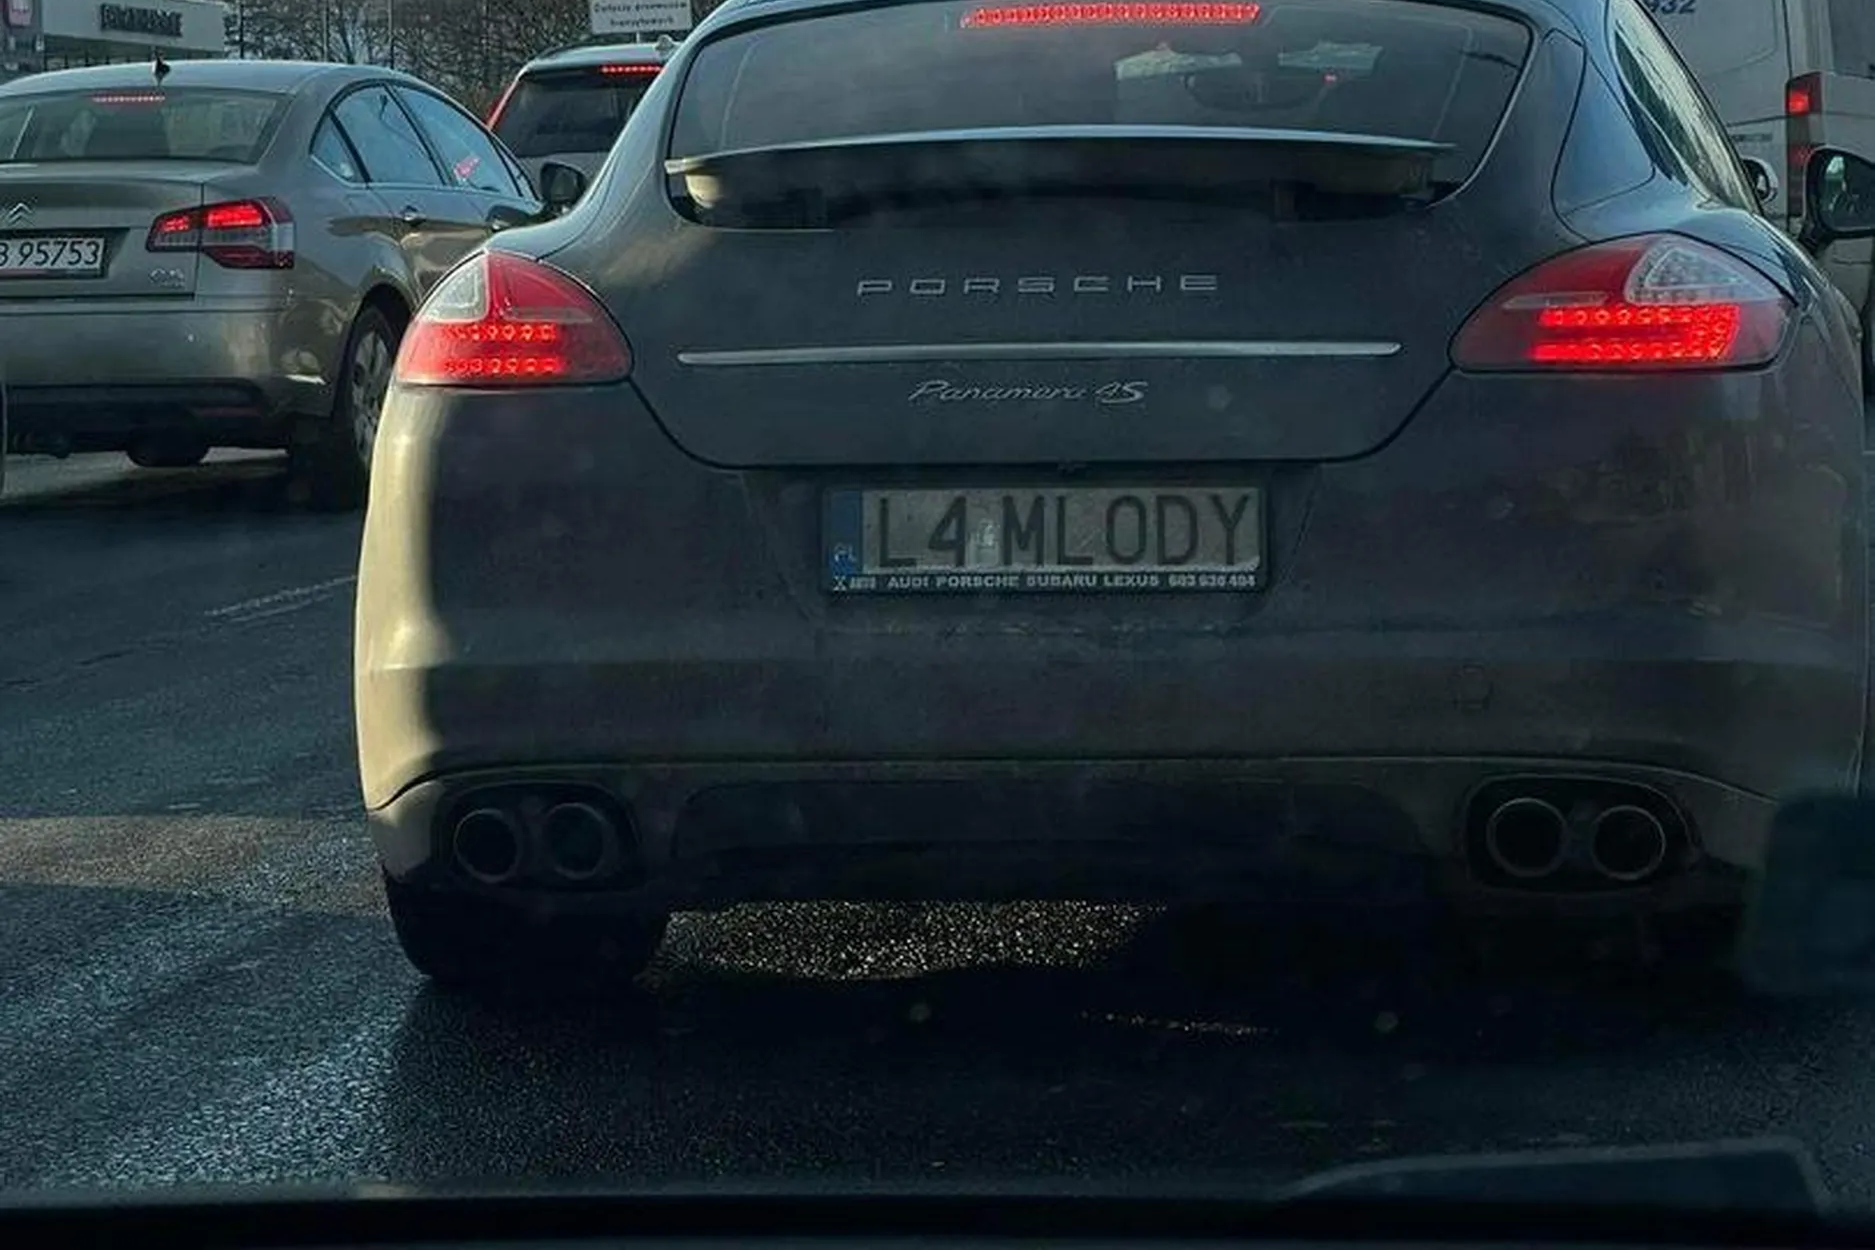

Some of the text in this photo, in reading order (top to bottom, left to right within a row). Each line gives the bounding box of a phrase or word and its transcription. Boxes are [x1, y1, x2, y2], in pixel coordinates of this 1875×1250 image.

[18, 240, 100, 266] 95753
[856, 275, 1218, 296] PORSCHE
[908, 379, 1149, 404] Panamera 4S
[878, 494, 1250, 567] L4 MLODY
[886, 575, 930, 589] AUDI
[936, 574, 1020, 588] PORSCHE
[1026, 574, 1097, 588] SUBARU
[1103, 573, 1160, 587] LEXUS
